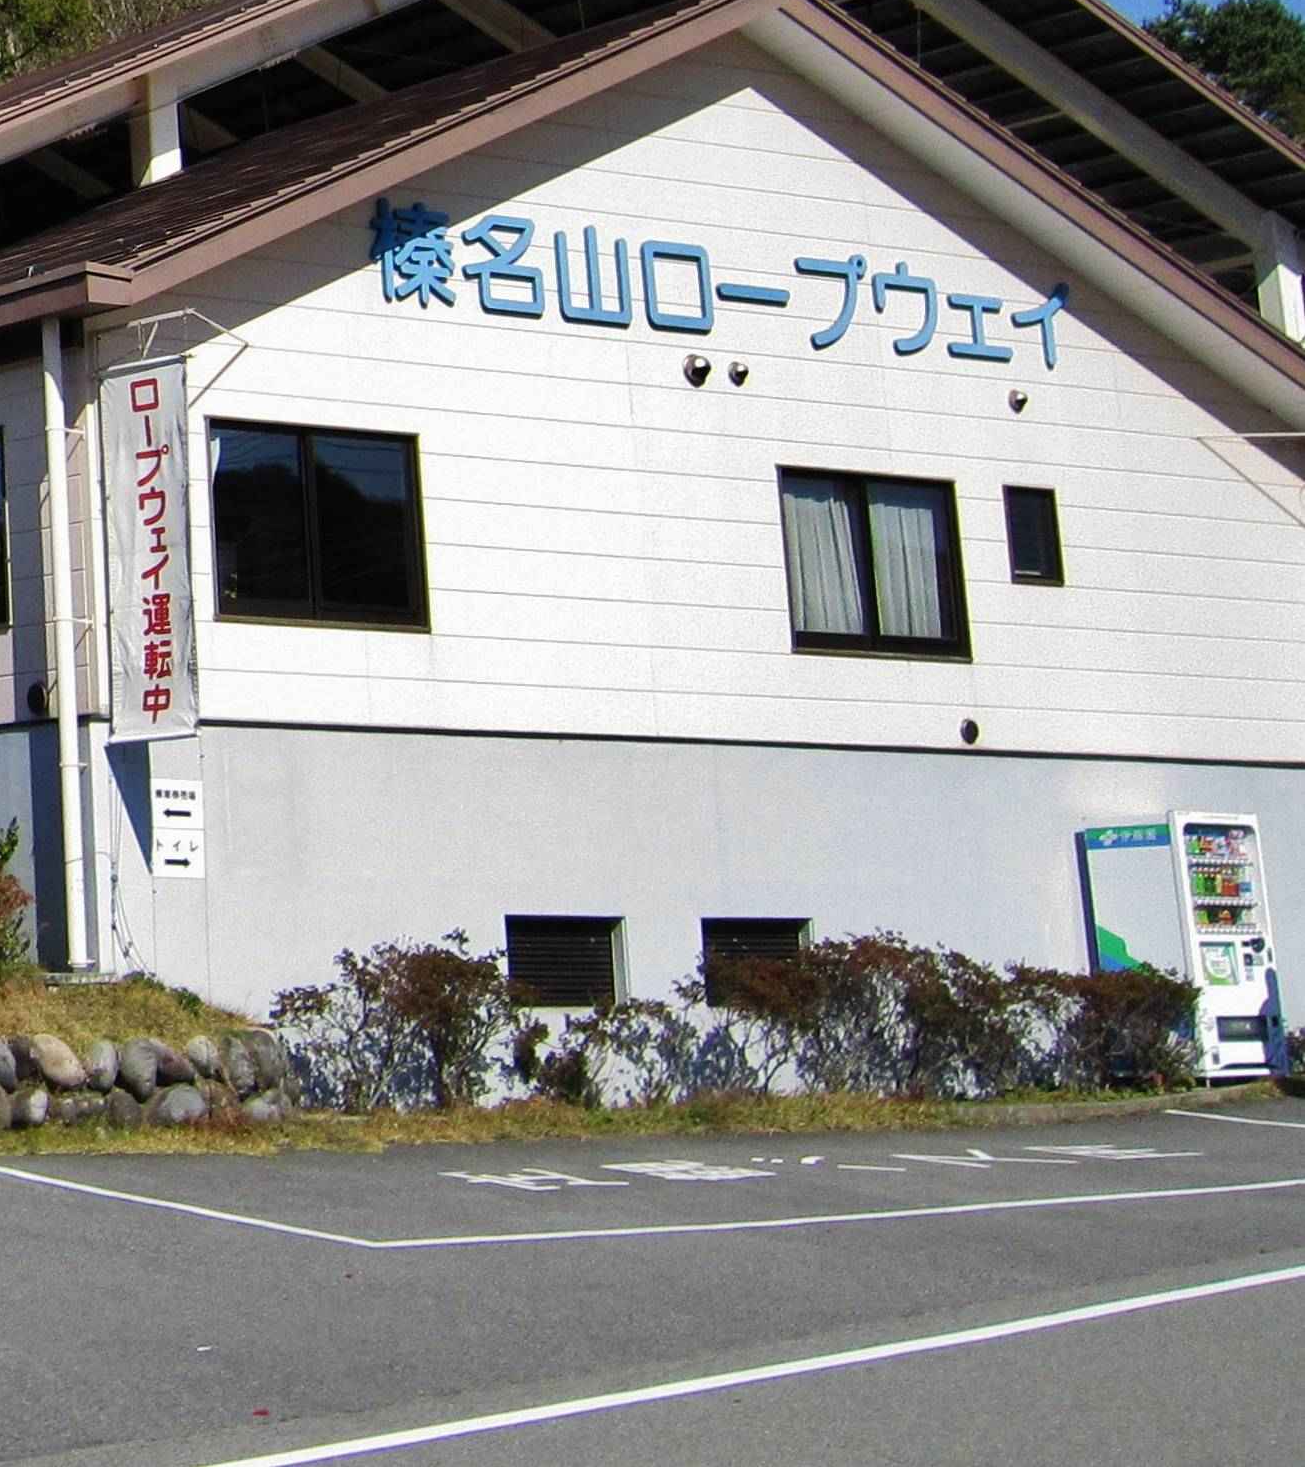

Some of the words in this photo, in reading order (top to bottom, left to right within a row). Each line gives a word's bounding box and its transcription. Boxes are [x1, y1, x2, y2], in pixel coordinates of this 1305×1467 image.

[370, 198, 1069, 369] 榛名山ロープウェイ
[129, 378, 174, 723] ロープウェイ運転中
